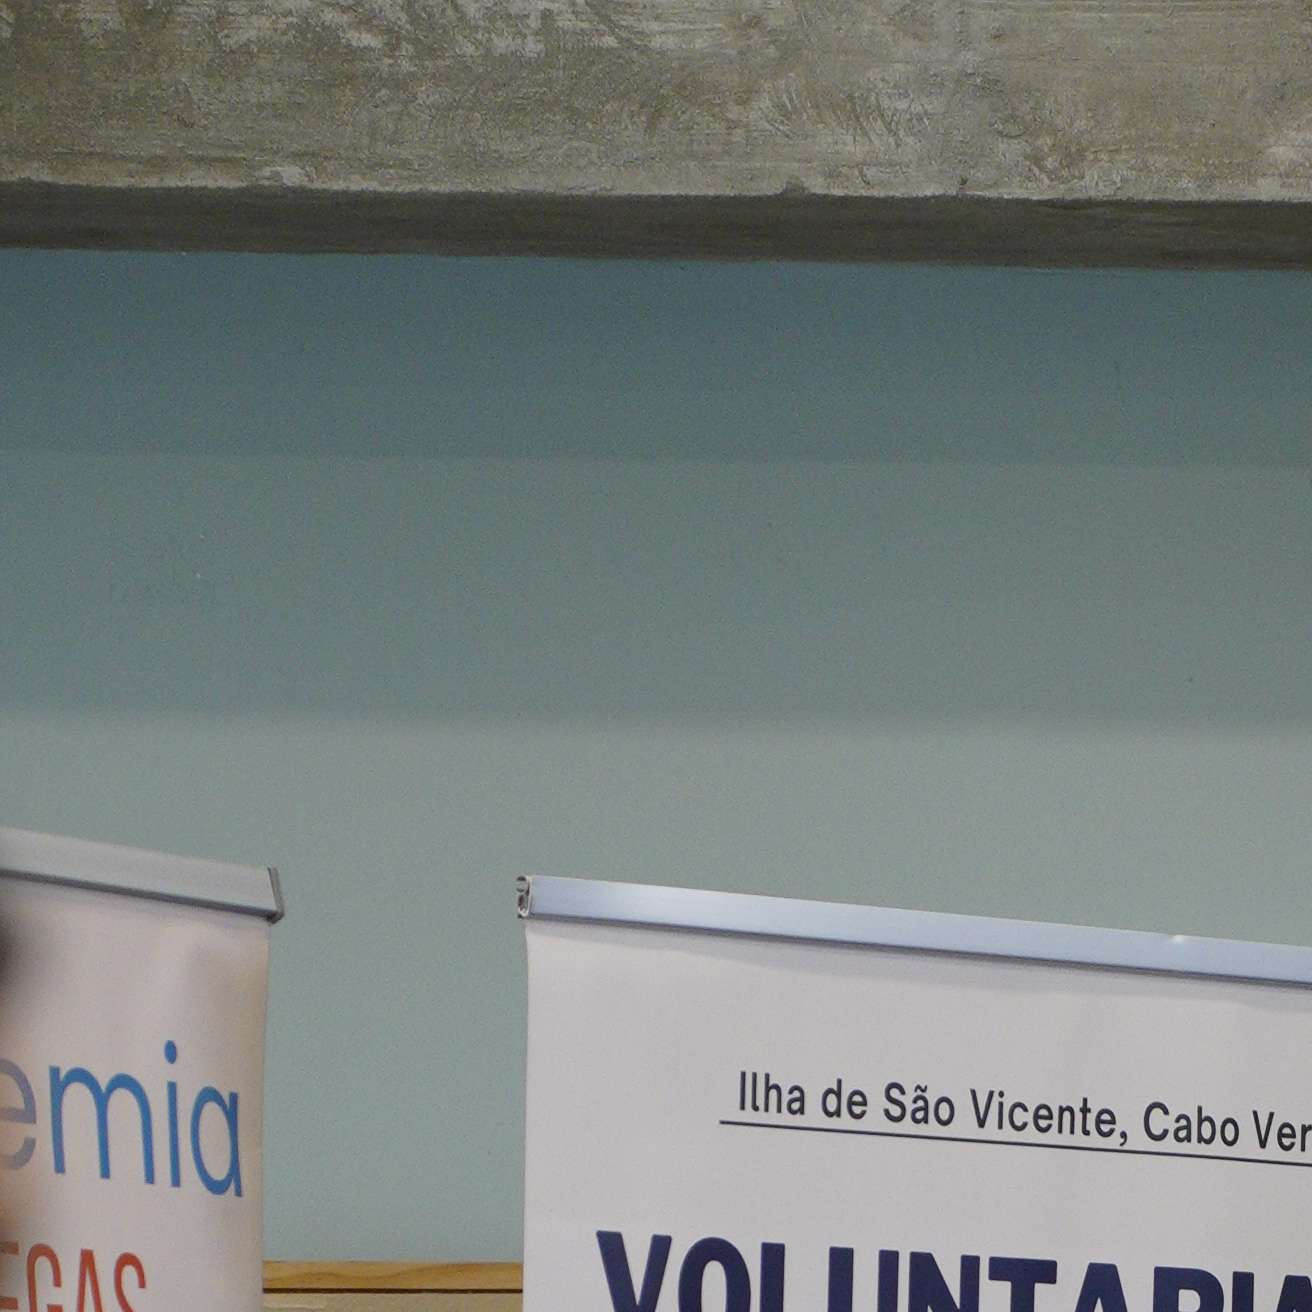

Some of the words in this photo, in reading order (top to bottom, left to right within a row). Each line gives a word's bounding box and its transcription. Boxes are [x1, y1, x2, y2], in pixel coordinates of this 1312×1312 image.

[738, 1070, 806, 1116] Ilha
[821, 1078, 868, 1120] de
[882, 1081, 955, 1126] São
[969, 1088, 1129, 1147] Vicente,
[1143, 1101, 1240, 1147] Cabo
